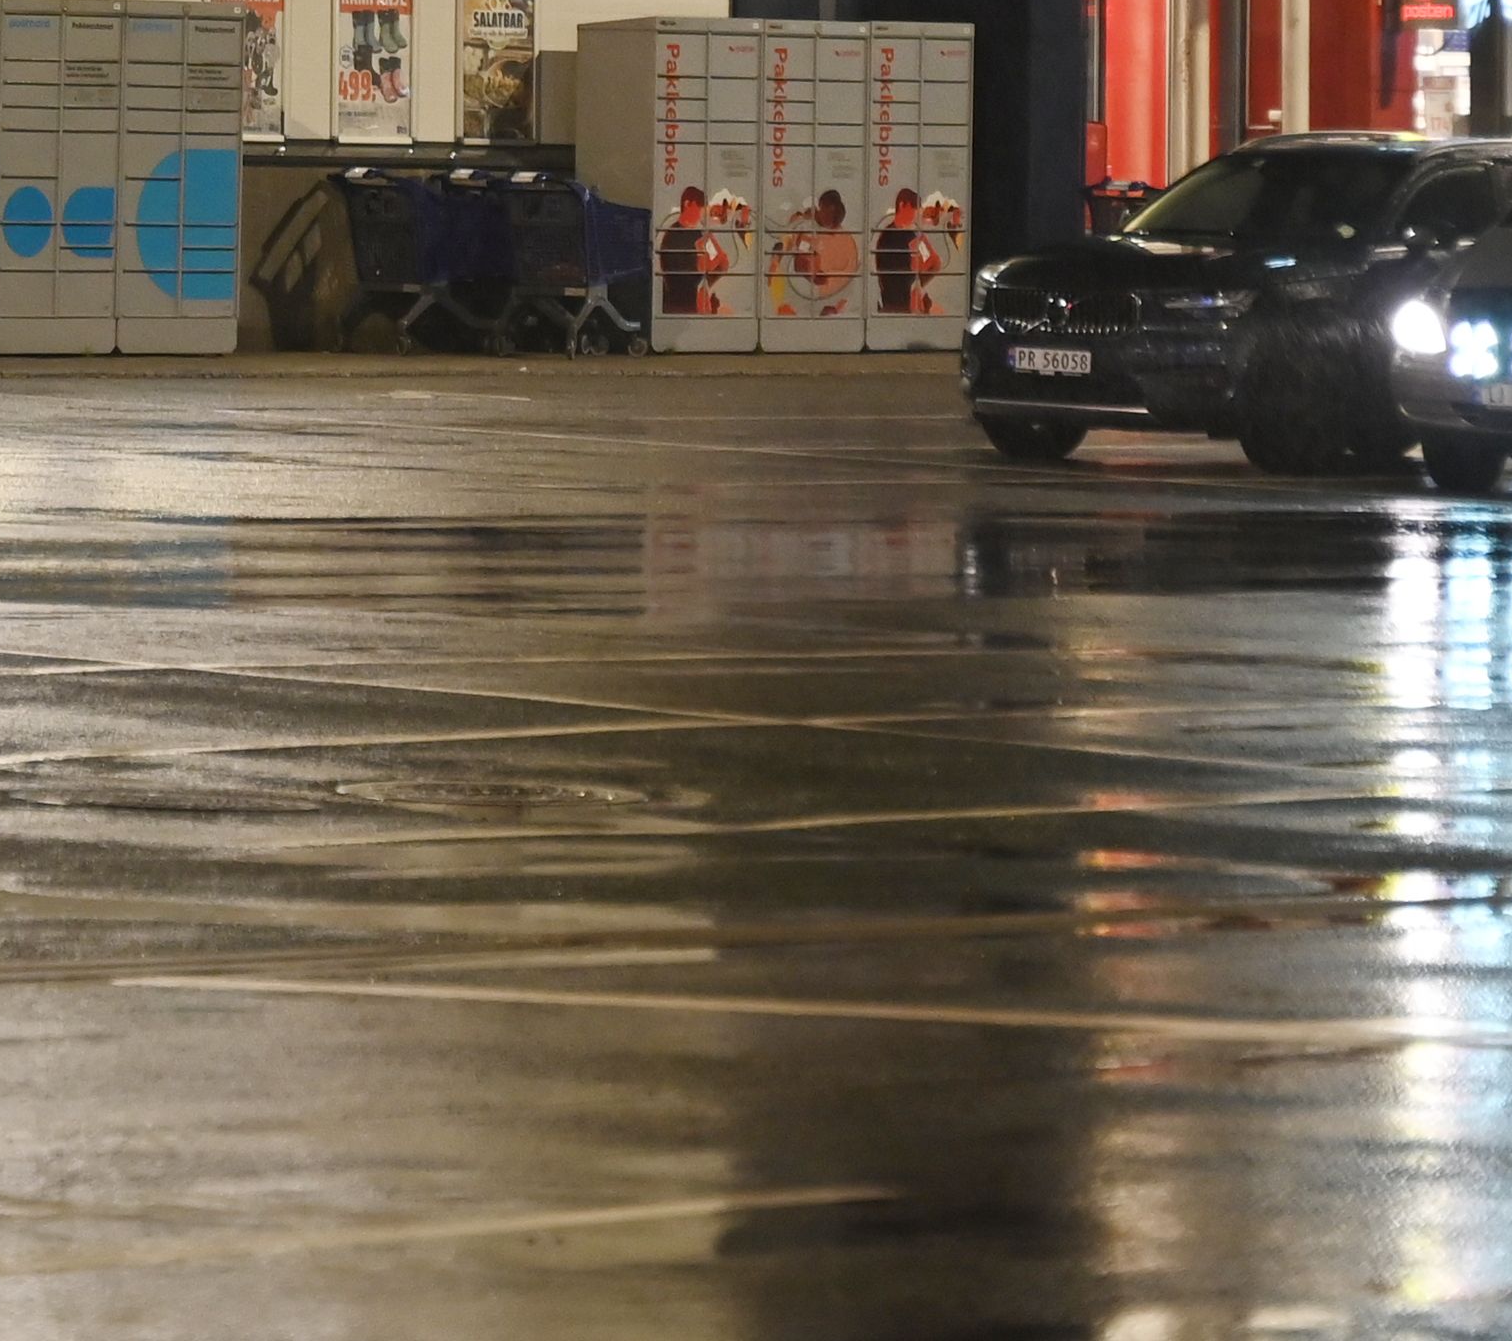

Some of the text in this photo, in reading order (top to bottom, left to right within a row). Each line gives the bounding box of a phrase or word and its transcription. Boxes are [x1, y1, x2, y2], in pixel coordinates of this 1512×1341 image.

[473, 10, 524, 29] SALATBAR
[1402, 3, 1454, 22] posten
[664, 43, 681, 187] Pakkeboks
[772, 47, 789, 189] Pakkeboks
[878, 47, 895, 188] Pakkeboks
[1018, 350, 1088, 371] PR 56058
